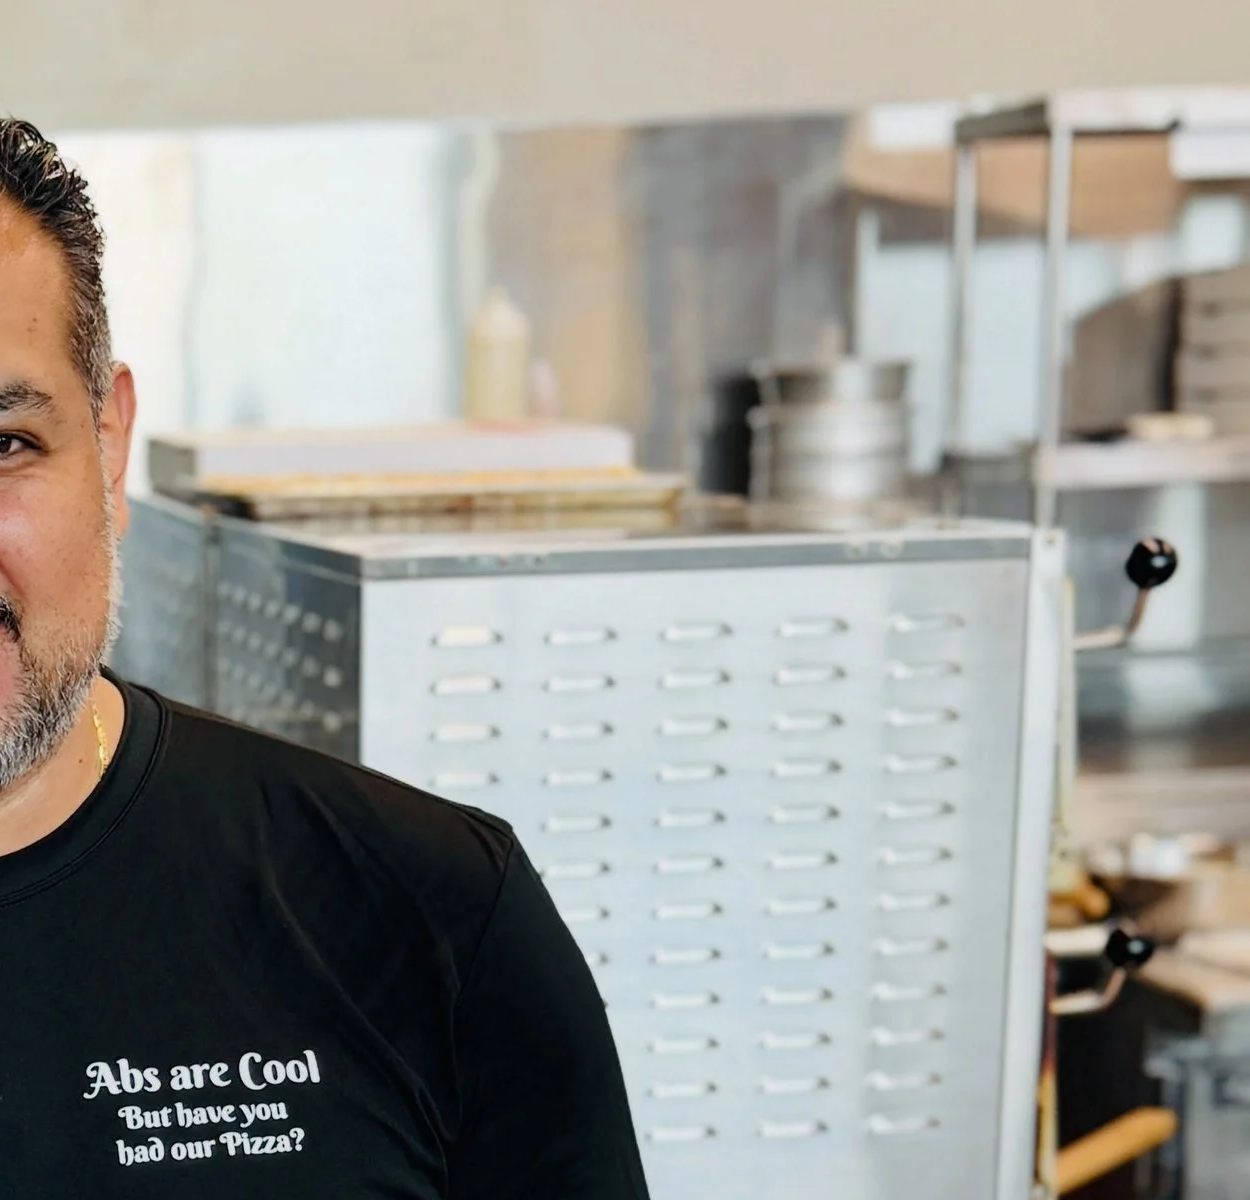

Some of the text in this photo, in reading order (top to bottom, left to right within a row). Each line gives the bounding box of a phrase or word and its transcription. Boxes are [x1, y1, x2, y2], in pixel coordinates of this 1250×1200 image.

[83, 1049, 321, 1100] Abs are Cool
[117, 1101, 289, 1130] But have you
[115, 1127, 306, 1167] had our Pizza?
